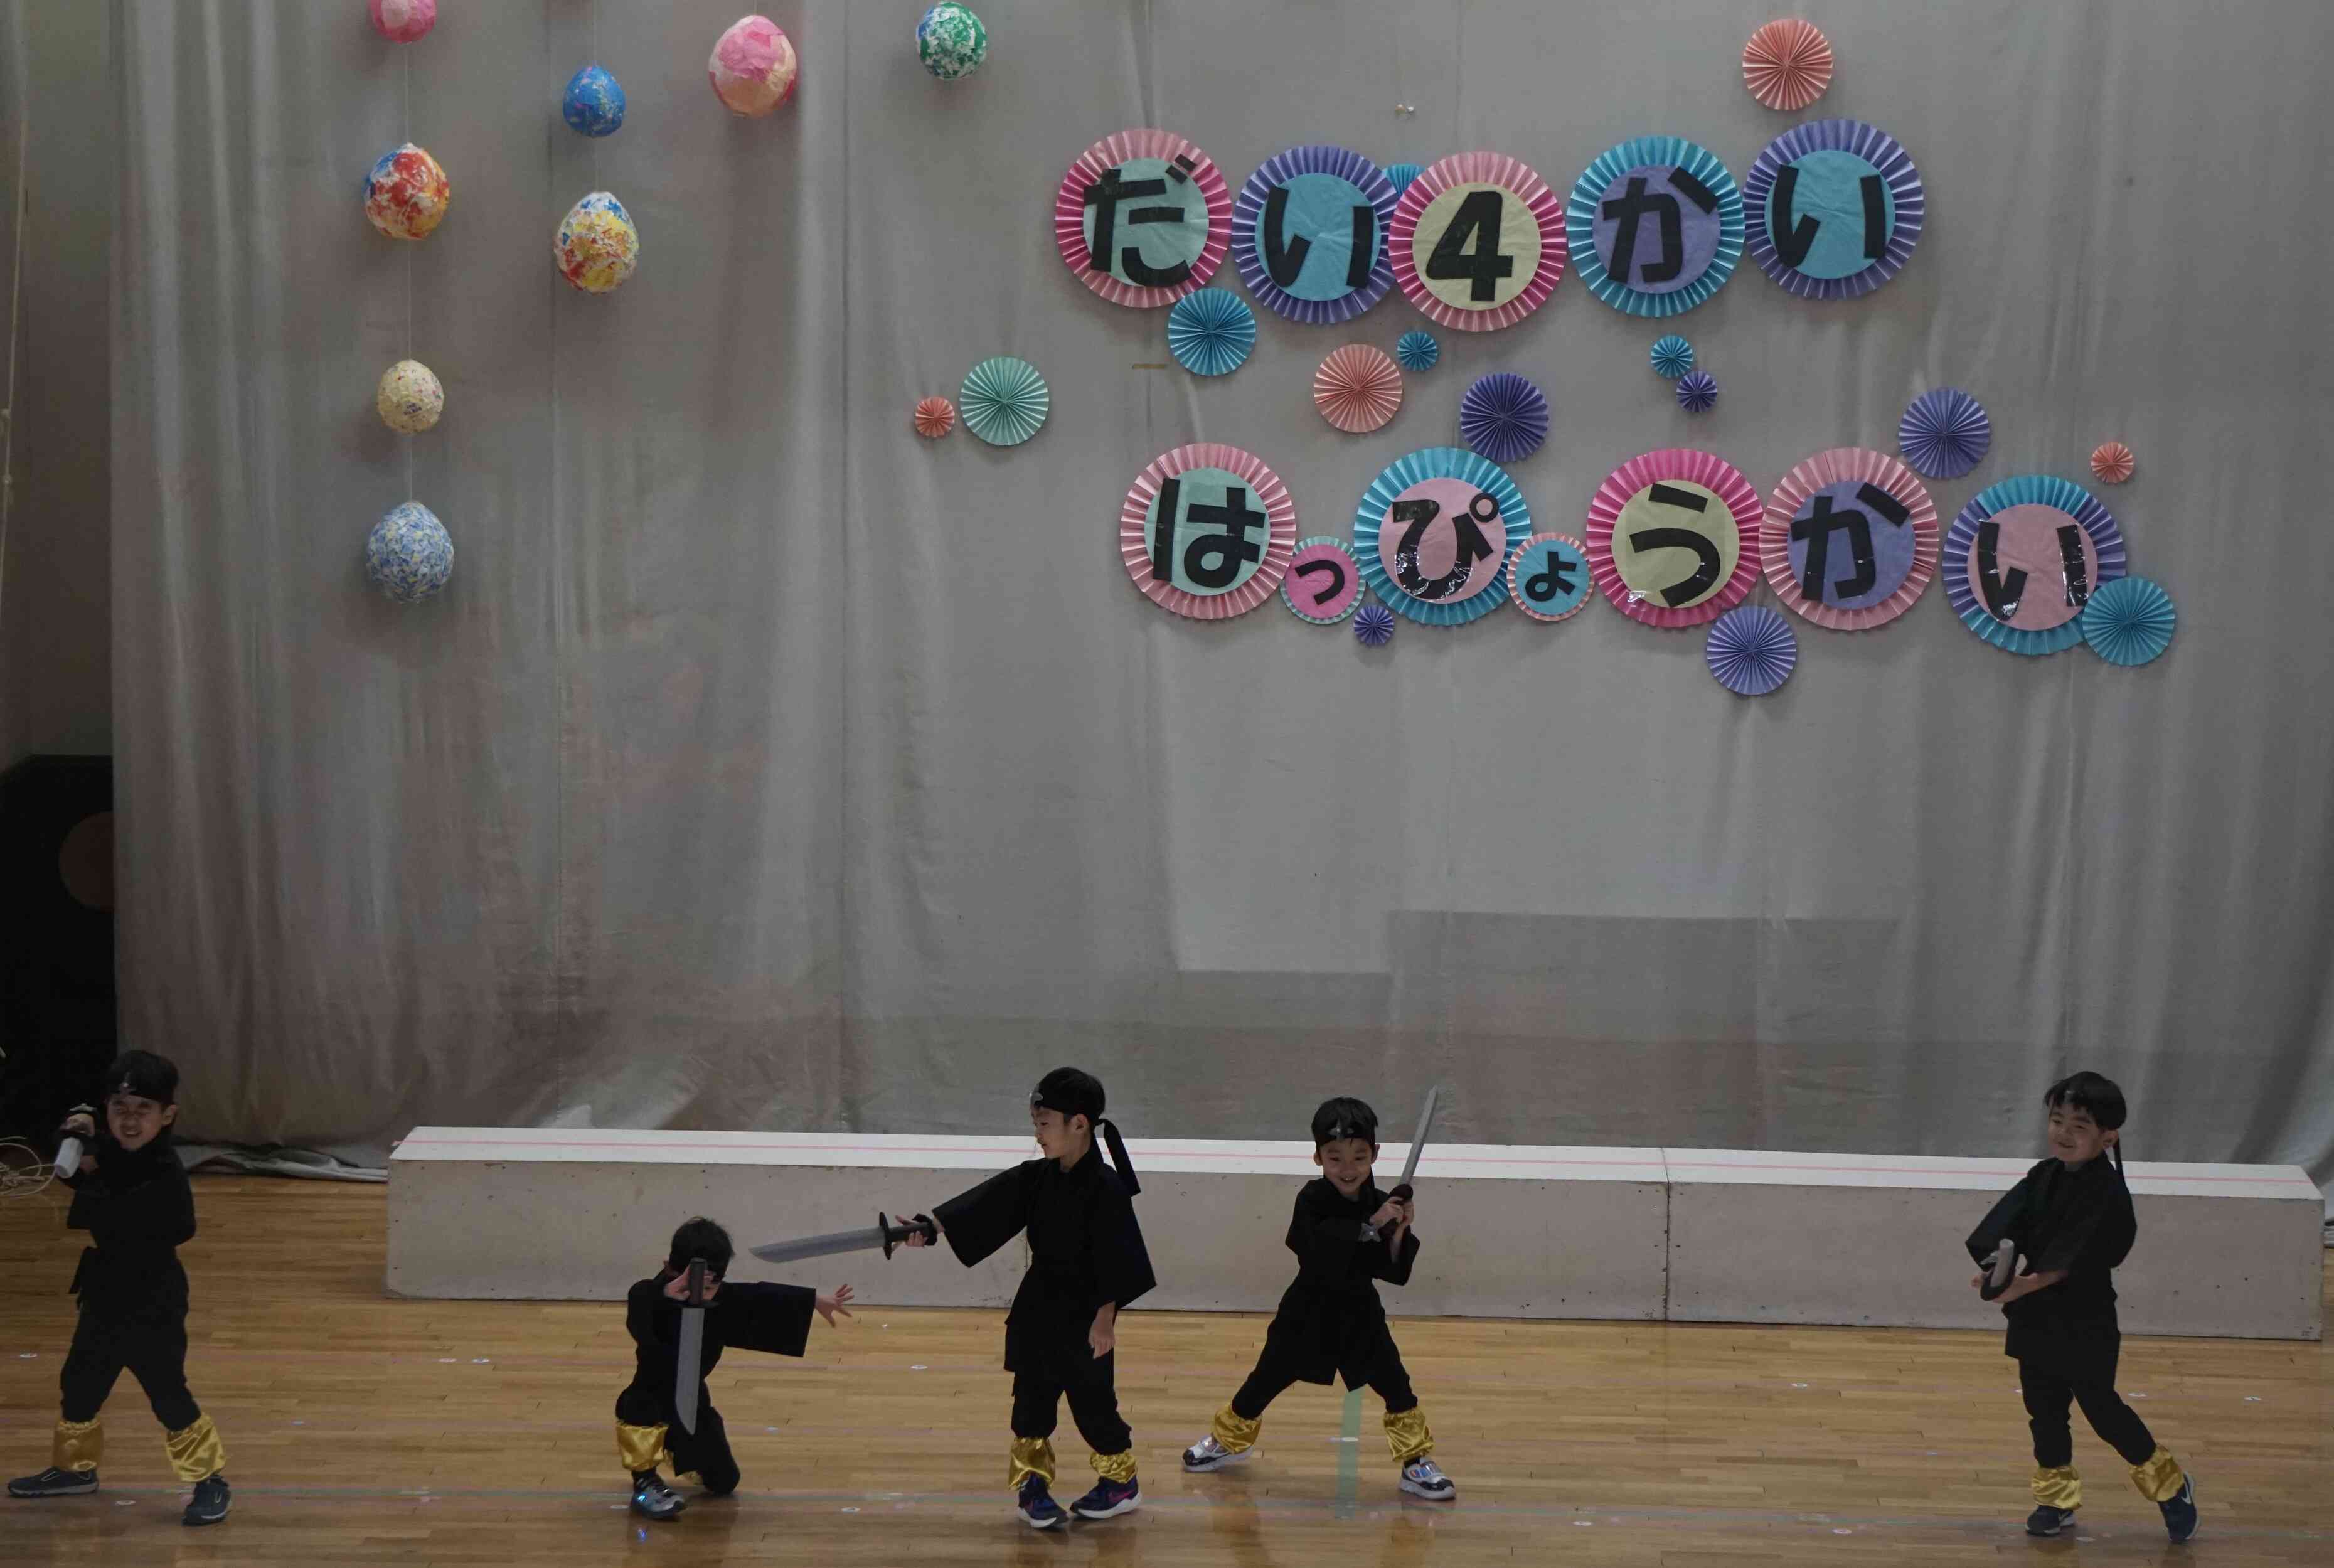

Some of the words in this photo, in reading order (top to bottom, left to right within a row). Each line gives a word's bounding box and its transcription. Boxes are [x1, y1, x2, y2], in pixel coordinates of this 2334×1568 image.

[1083, 154, 1886, 302] だい4かい
[1153, 477, 2088, 621] はっぴょうかい
